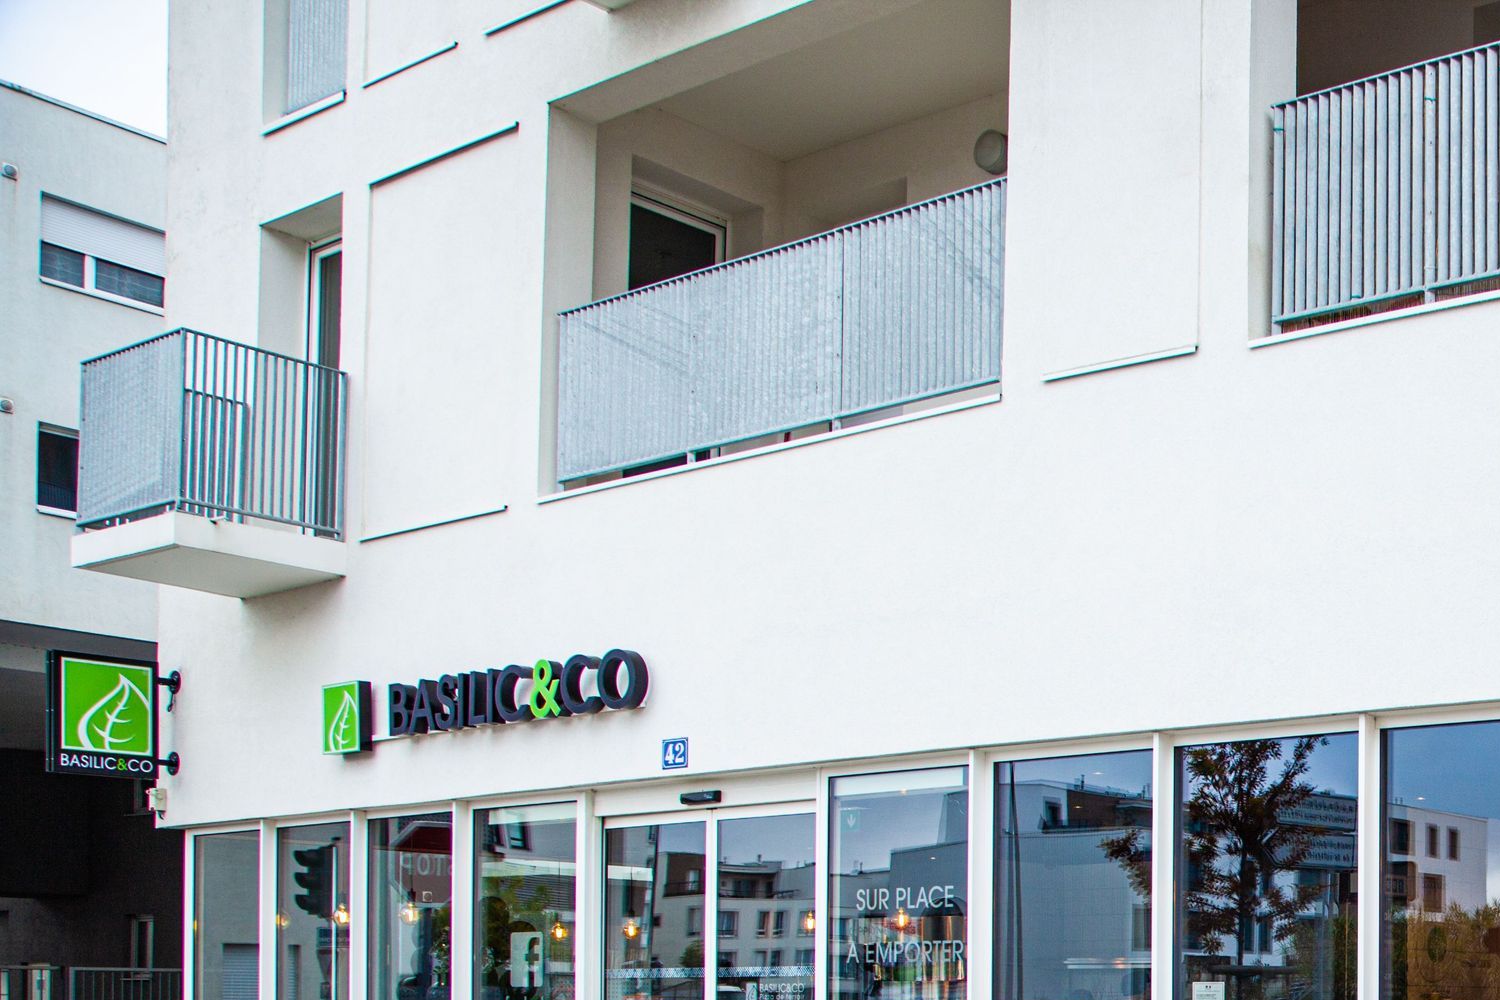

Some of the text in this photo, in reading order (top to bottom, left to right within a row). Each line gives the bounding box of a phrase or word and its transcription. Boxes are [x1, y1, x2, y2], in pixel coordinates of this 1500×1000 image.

[387, 648, 649, 737] BASILIC&CO
[60, 752, 153, 773] BASILIC&CO
[664, 742, 685, 765] 42
[856, 885, 955, 911] SUR PLACE
[865, 939, 964, 963] EMPORTER
